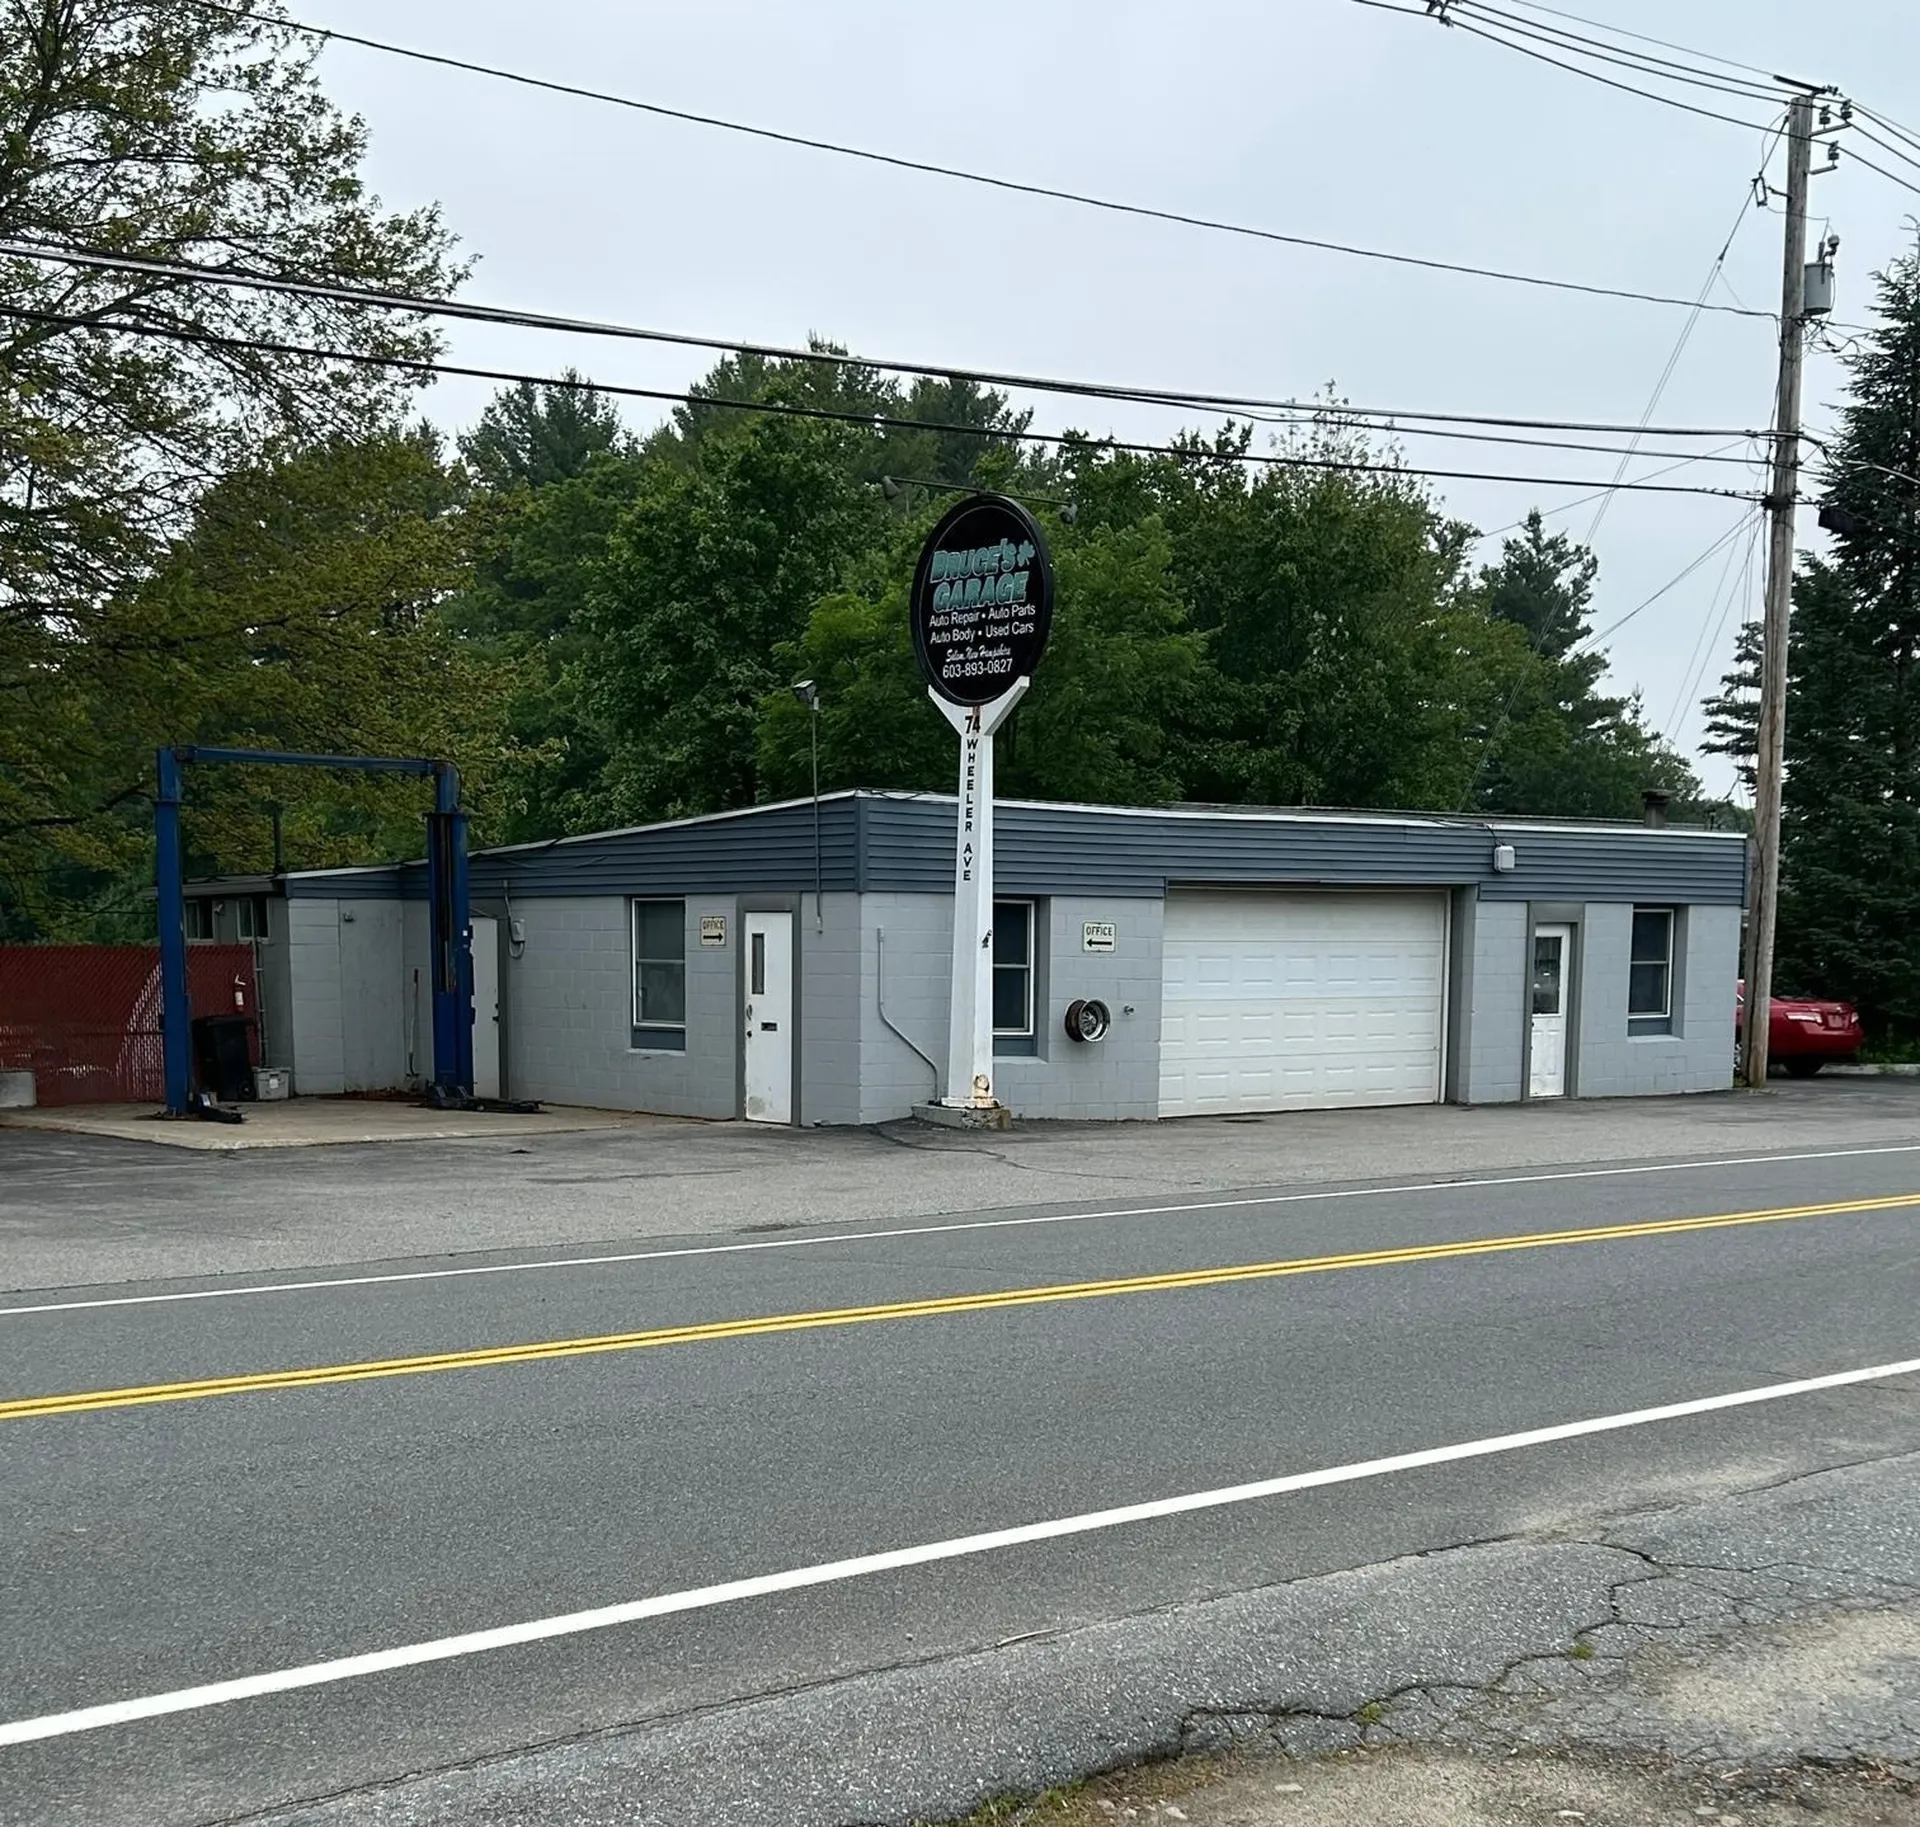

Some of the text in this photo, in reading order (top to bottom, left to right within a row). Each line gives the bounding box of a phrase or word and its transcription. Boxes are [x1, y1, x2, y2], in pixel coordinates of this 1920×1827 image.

[932, 571, 1029, 612] GARAGE
[929, 603, 1036, 627] Auto Repair Auto Parts
[930, 621, 1035, 644] Auto Body Used Cars
[979, 643, 1011, 659] Hampshire
[942, 659, 1013, 678] 603-893-0827
[964, 715, 979, 733] 74
[963, 739, 979, 881] WHEELER AVE
[703, 920, 724, 930] OFFICE
[1086, 926, 1113, 936] OFFICE
